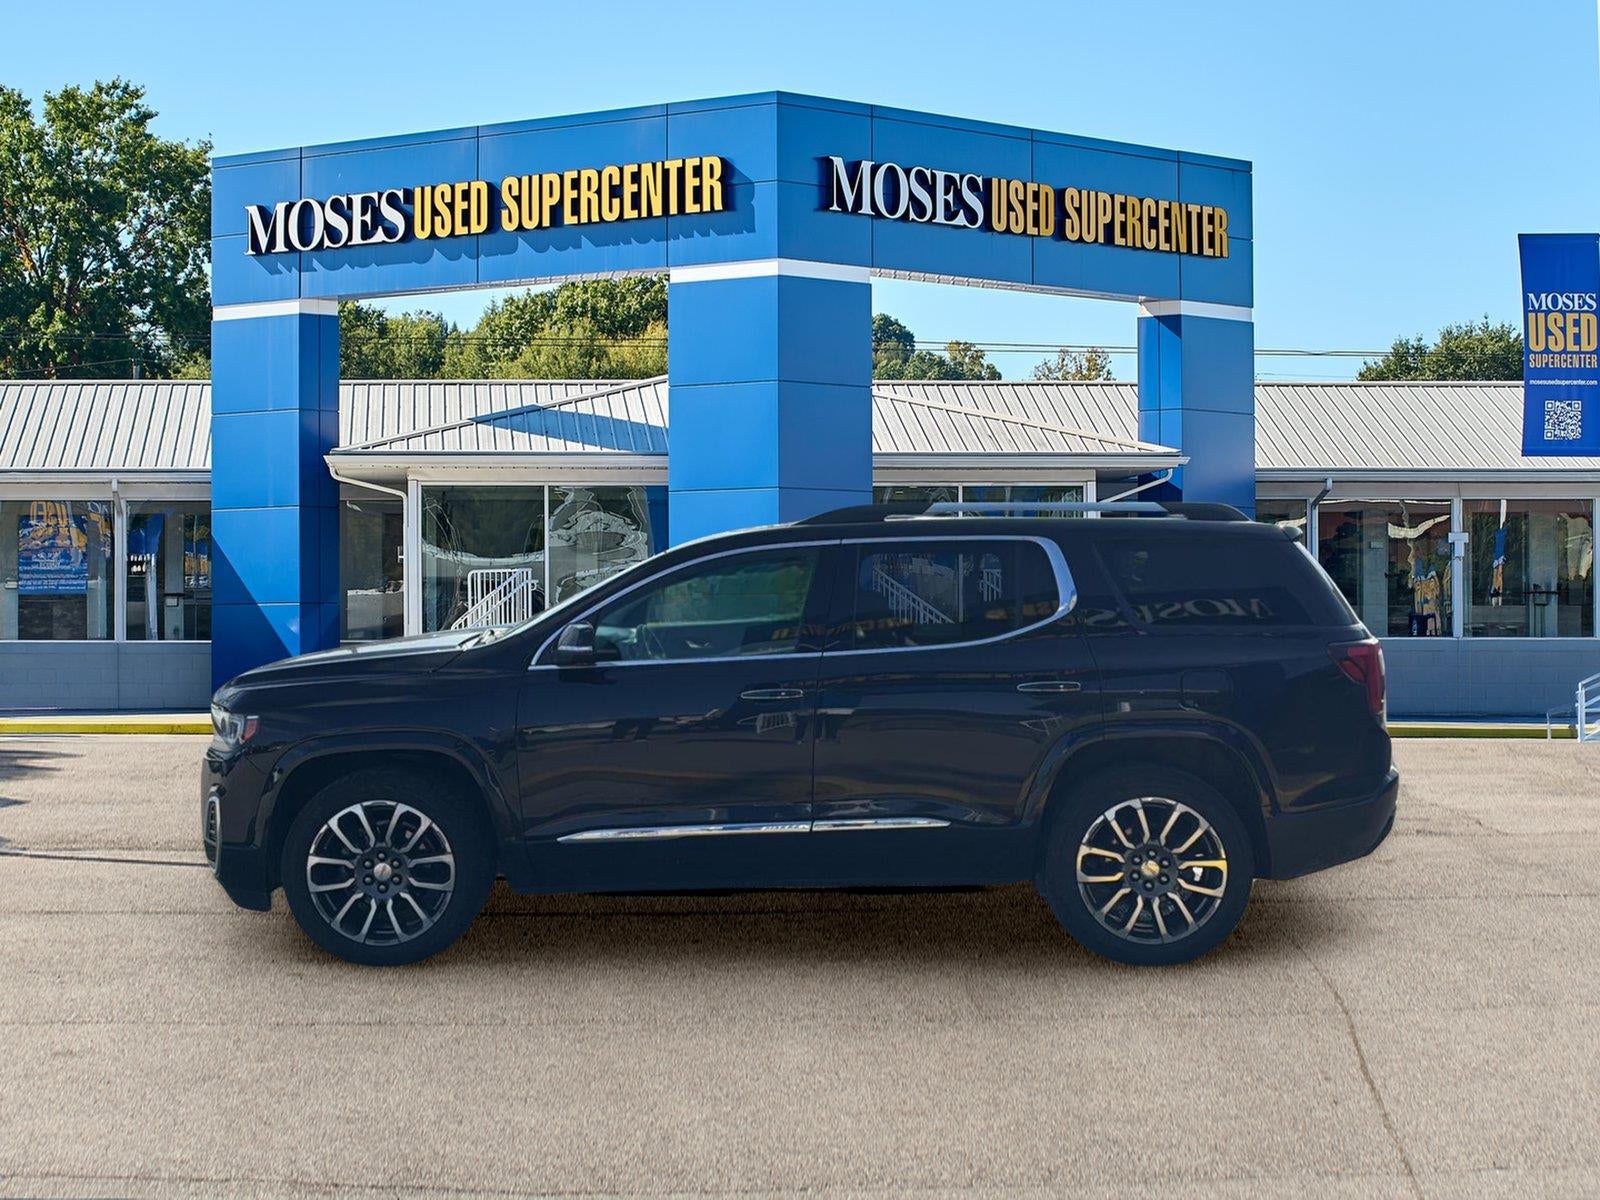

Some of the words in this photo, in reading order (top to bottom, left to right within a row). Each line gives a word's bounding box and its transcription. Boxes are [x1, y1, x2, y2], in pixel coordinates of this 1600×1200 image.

[244, 188, 407, 257] MOSES
[413, 180, 487, 240] USED
[500, 156, 723, 232] SUPERCENTER
[829, 156, 984, 229] MOSES
[991, 177, 1055, 237] USED
[1065, 187, 1229, 258] SUPERCENTER
[1527, 292, 1597, 311] MOSES
[1528, 312, 1598, 352] USED
[1529, 353, 1598, 368] SUPERCENTER
